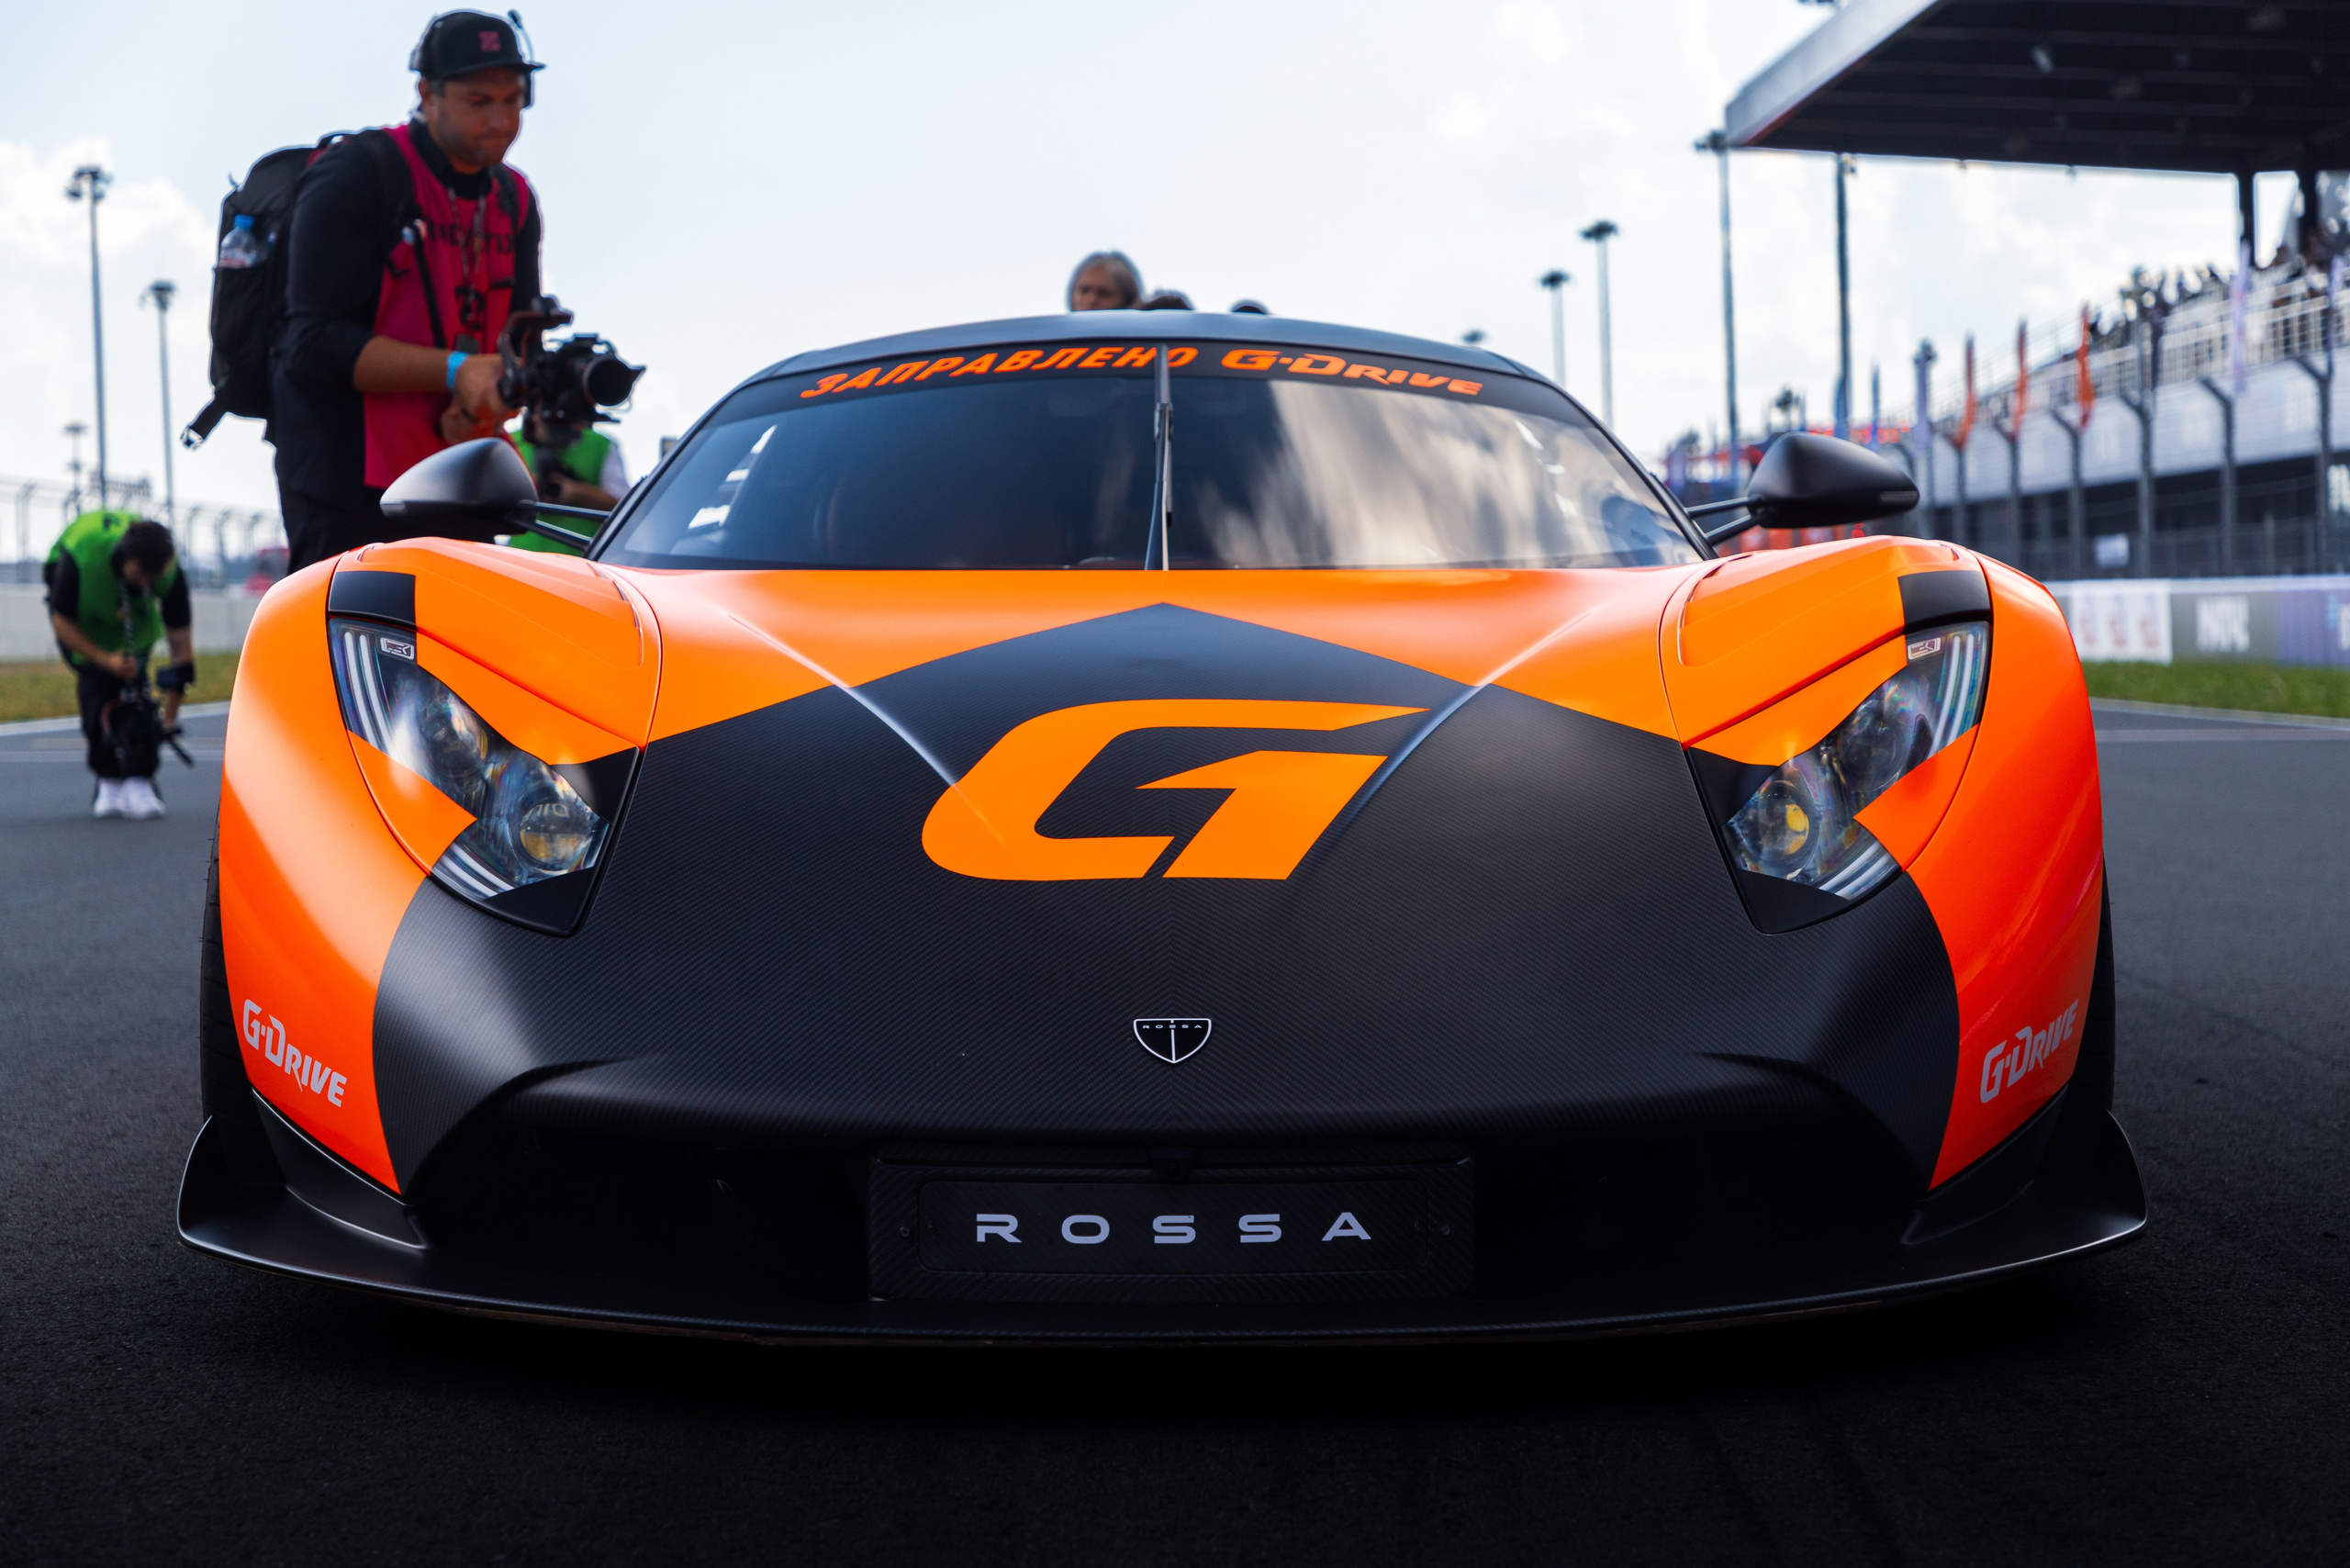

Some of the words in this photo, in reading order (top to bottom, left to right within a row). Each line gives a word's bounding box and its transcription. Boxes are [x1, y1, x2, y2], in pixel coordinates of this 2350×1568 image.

[800, 346, 1199, 398] ЗАПРАВЛЕНО
[921, 698, 1431, 881] G
[976, 1212, 1371, 1245] ROSSA
